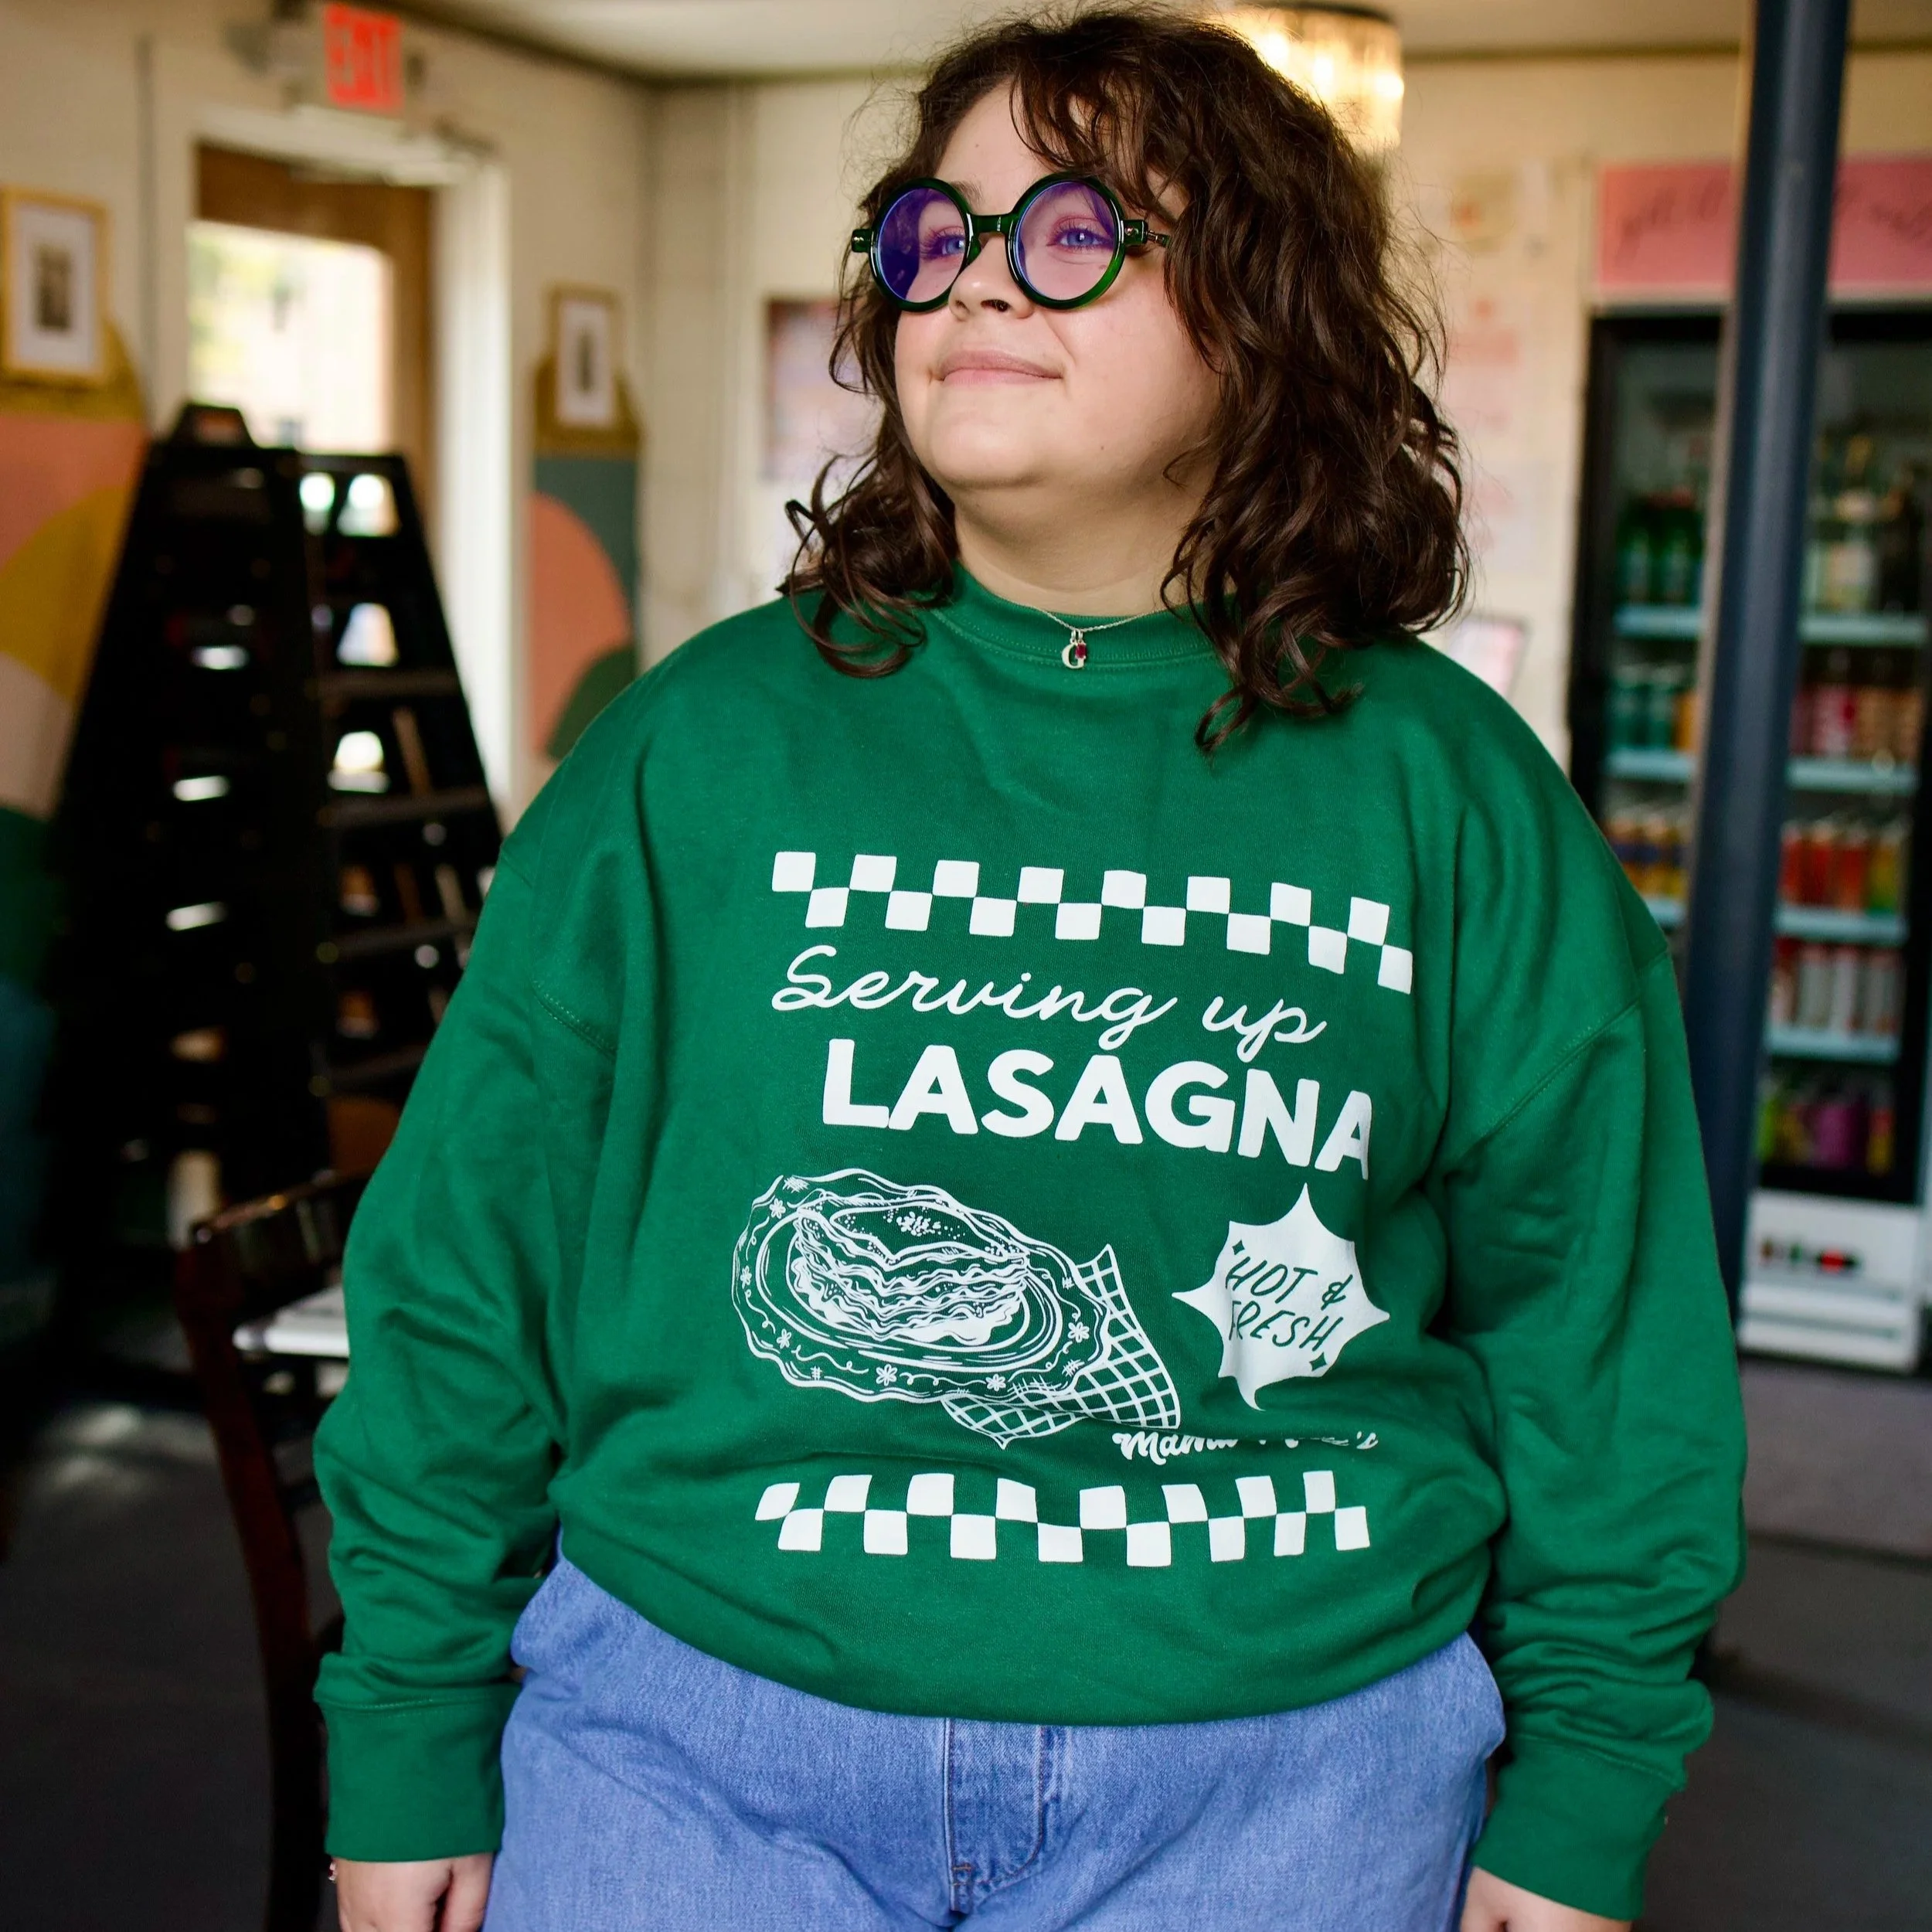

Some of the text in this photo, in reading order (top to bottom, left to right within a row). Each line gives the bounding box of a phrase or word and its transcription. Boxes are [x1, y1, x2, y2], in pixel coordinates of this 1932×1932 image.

[771, 944, 1327, 1063] Serving up
[822, 1038, 1371, 1181] LASAGNA
[1226, 1256, 1354, 1310] HOT &
[1229, 1301, 1344, 1351] FRESH
